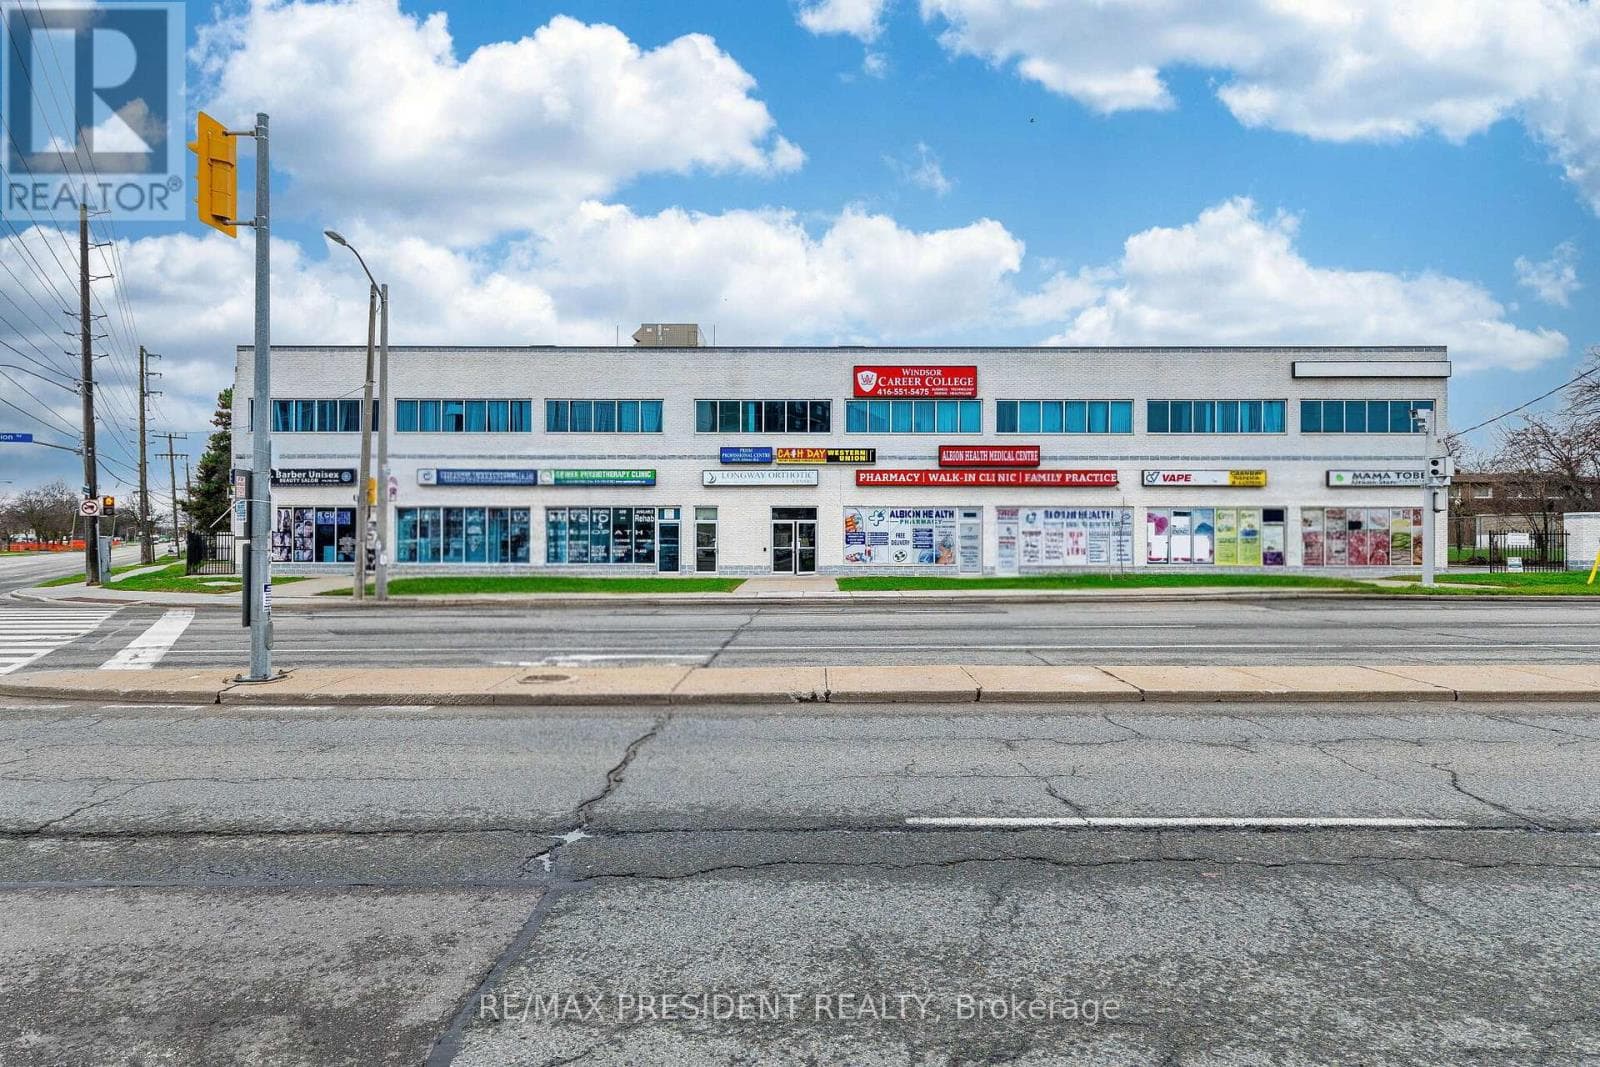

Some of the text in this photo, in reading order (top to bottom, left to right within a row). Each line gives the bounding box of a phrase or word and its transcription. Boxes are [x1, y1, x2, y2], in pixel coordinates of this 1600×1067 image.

[902, 368, 942, 376] WINDSOR
[878, 376, 975, 387] CAREER COLLEGE
[877, 388, 930, 396] 416-551-5475
[806, 449, 827, 458] DAY
[942, 450, 1039, 462] ALBION HEALTH MEDICAL CENTRE
[275, 470, 340, 479] Barber Unisex
[720, 471, 815, 480] LONGWAY ORTHOTIC
[859, 472, 1117, 482] PHARMACY WALK-IN CLINIC FAMILY PRACTICE
[1162, 474, 1193, 482] VAPE
[1352, 472, 1391, 480] MAMA
[922, 510, 955, 519] HEALTH
